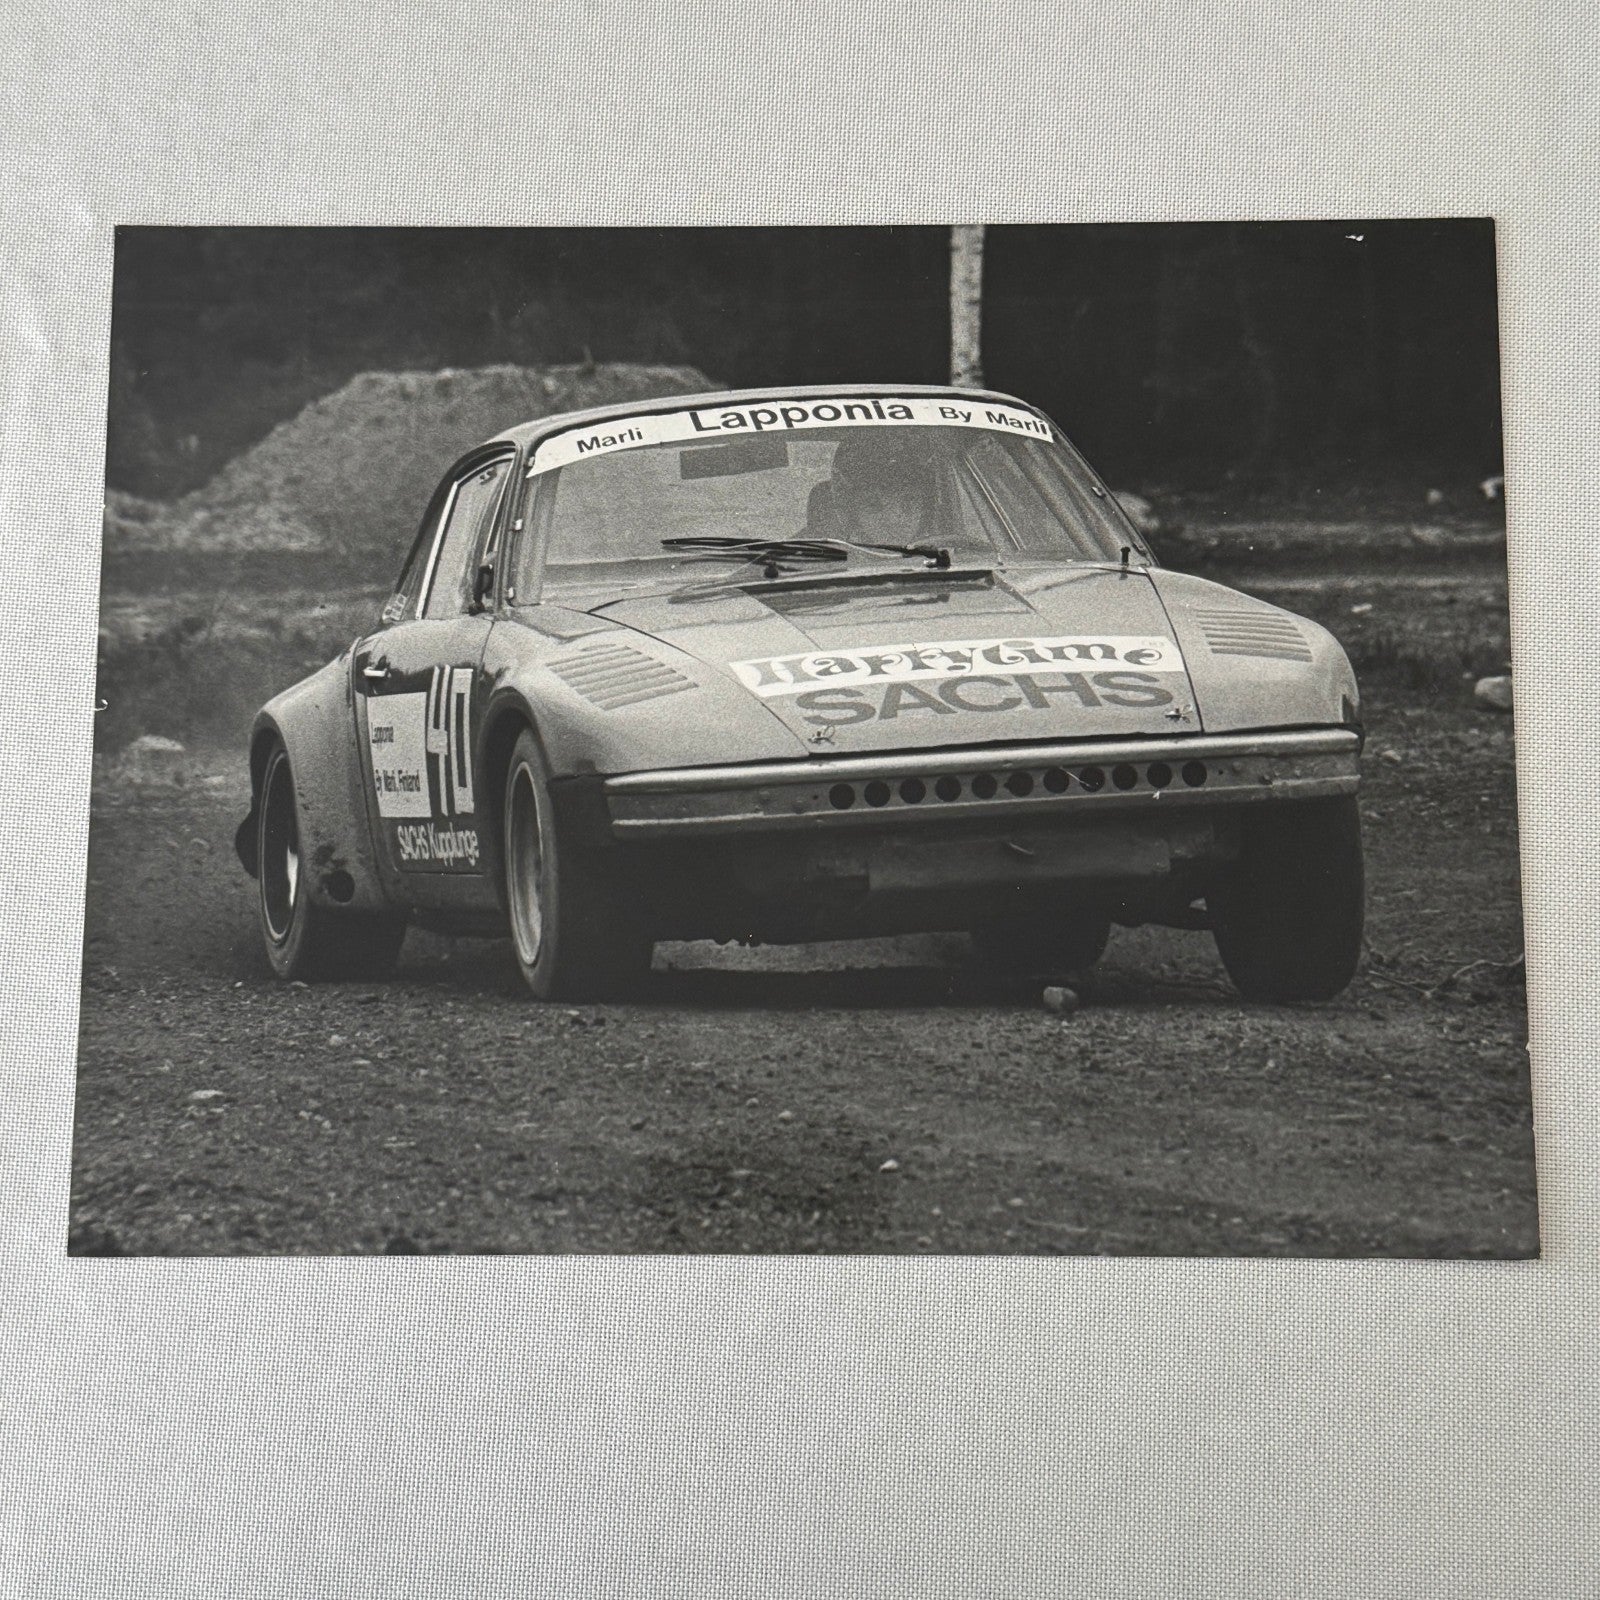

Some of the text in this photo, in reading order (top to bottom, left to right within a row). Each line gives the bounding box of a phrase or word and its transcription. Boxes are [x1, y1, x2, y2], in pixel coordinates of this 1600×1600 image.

[577, 399, 1047, 453] Marli Lapponia By Marli
[795, 671, 1173, 726] SACHS
[397, 825, 430, 860] SACHS
